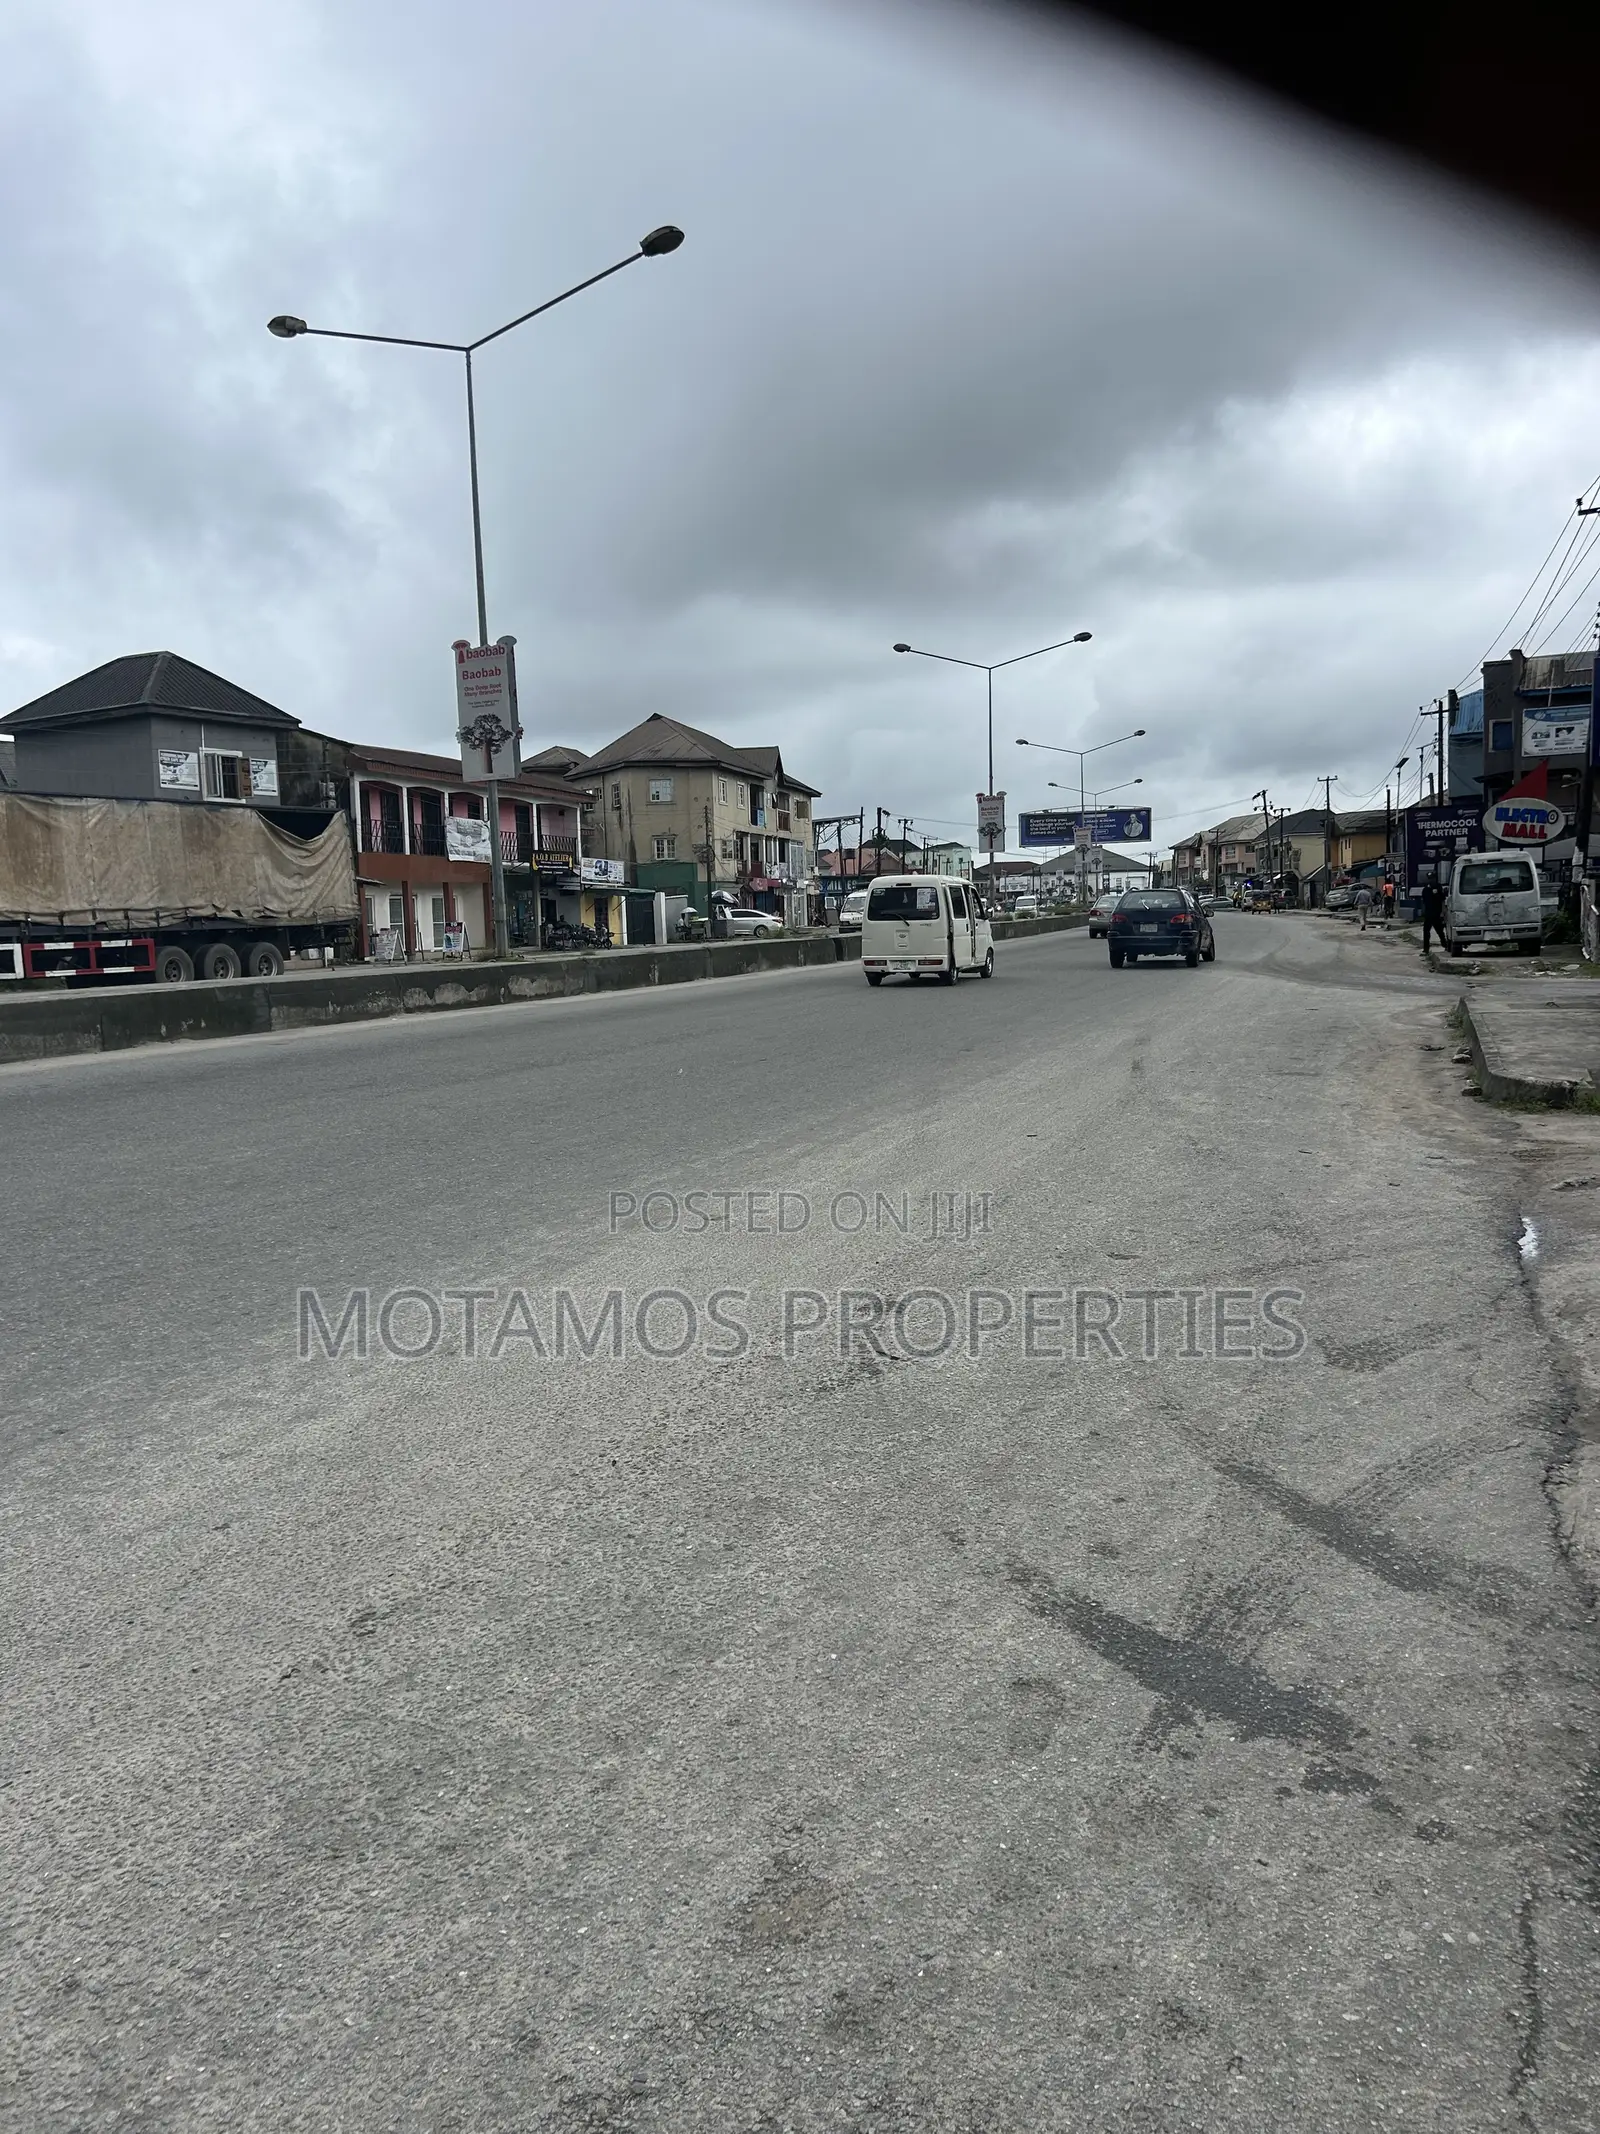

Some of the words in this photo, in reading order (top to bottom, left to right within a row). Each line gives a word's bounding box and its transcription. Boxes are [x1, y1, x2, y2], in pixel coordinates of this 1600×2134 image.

[466, 646, 505, 660] baobab
[462, 666, 502, 680] Baobab
[1494, 807, 1559, 825] ELECTRO
[1416, 818, 1478, 830] THERMOCOOL
[1501, 822, 1548, 839] MALL
[1425, 827, 1469, 838] PARTNER
